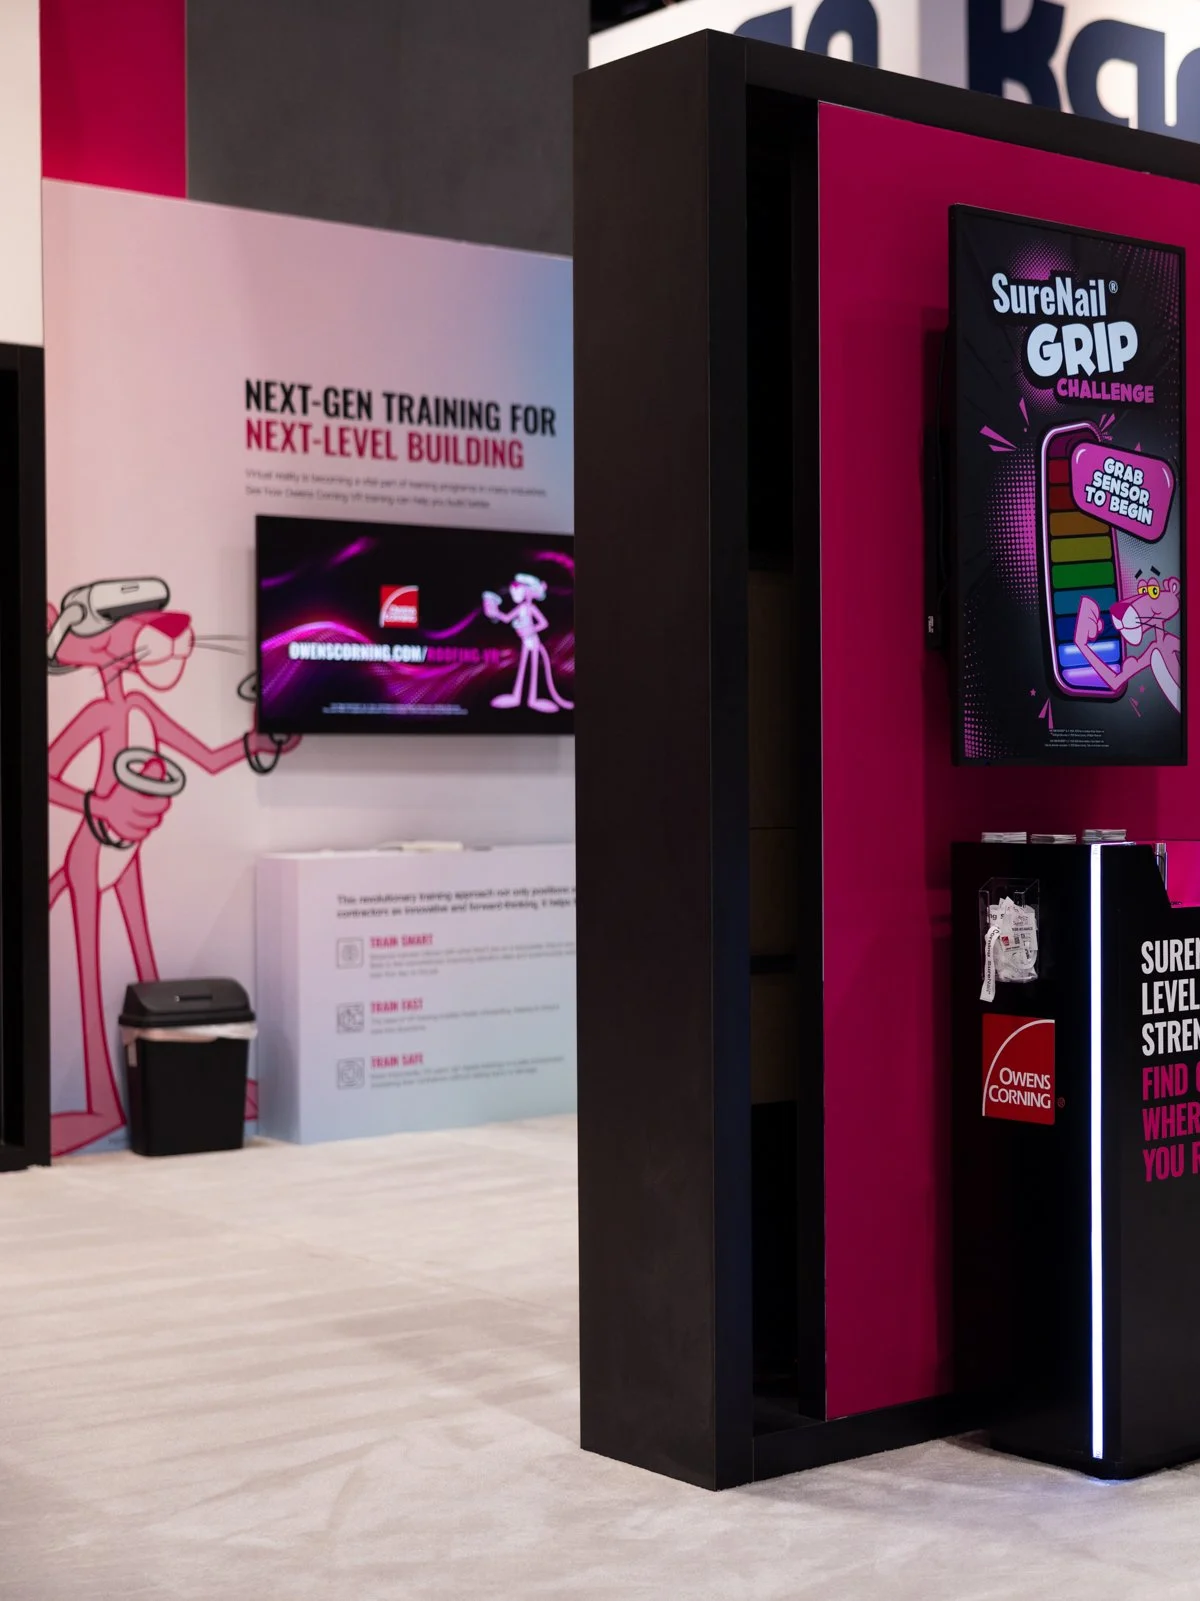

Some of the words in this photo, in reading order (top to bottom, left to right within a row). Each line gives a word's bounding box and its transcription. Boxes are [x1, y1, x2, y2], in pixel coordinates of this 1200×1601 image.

[1027, 321, 1139, 378] GRIP
[1056, 379, 1154, 403] CHALLENGE
[245, 379, 374, 422] NEXT-GEN
[383, 390, 502, 432] TRAINING
[510, 404, 557, 437] FOR
[245, 417, 398, 461] NEXT-LEVEL
[407, 429, 524, 470] BUILDING
[1103, 457, 1143, 486] GRAB
[1092, 471, 1150, 507] SENSOR
[1085, 486, 1104, 507] TO
[1109, 494, 1153, 526] BEGIN
[337, 895, 357, 905] This
[359, 895, 416, 904] revolutionary
[419, 892, 452, 902] training
[455, 889, 493, 901] approach
[513, 887, 530, 898] only
[532, 886, 570, 896] positions
[370, 936, 398, 949] TRAIN
[401, 933, 433, 946] SMART
[371, 1000, 398, 1014] TRAIN
[402, 998, 424, 1012] FAST
[1141, 981, 1200, 1016] LEVEL
[371, 1055, 399, 1069] TRAIN
[402, 1052, 424, 1066] SAFE
[999, 1066, 1051, 1091] OWENS
[1142, 1062, 1188, 1101] FIND
[988, 1083, 1052, 1110] CORNING
[1142, 1142, 1187, 1183] YOU
